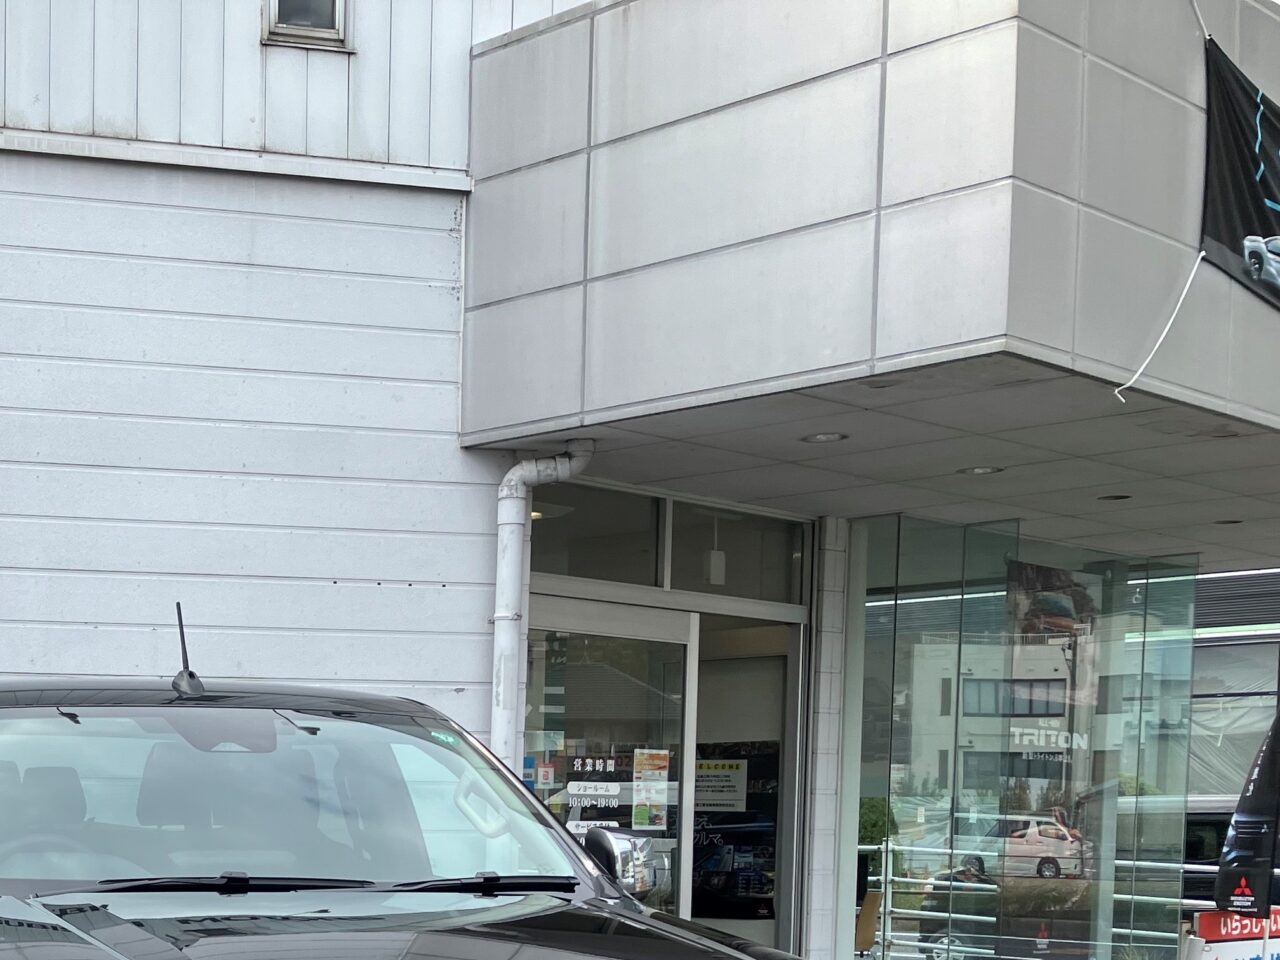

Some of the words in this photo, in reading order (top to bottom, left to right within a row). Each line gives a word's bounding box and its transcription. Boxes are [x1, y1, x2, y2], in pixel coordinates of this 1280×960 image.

[1009, 727, 1089, 750] TRITON
[573, 758, 616, 772] 営業時間
[576, 783, 610, 793] ショールーム
